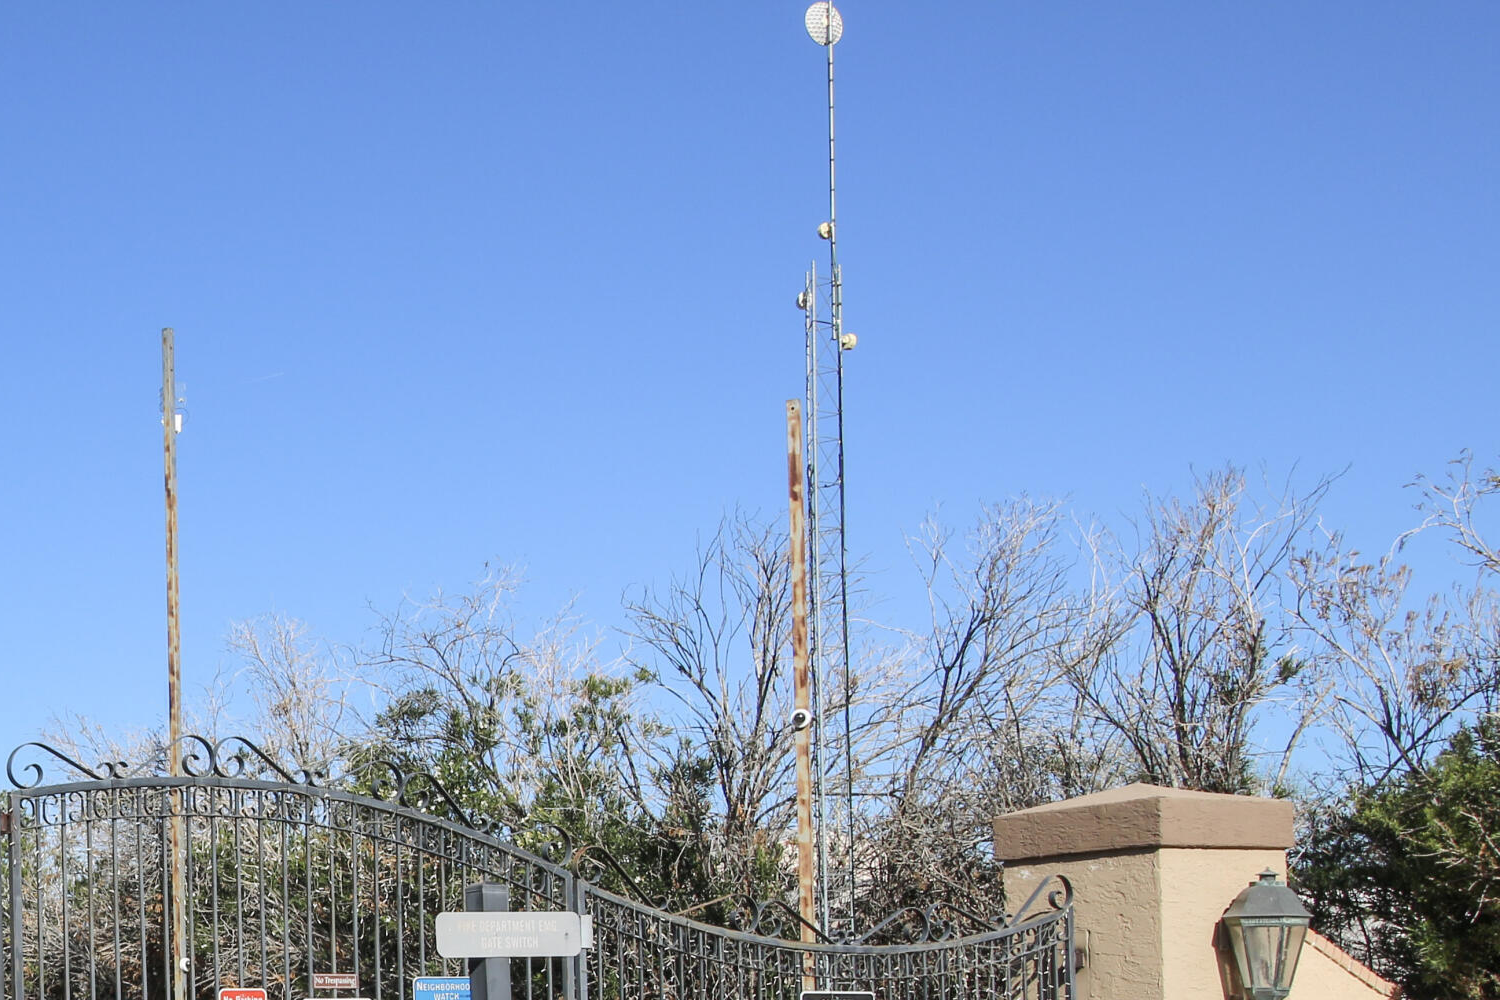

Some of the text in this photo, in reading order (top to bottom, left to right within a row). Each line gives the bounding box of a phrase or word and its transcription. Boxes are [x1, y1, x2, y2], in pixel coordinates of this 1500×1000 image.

[479, 920, 535, 932] DEPARTMENT
[481, 936, 539, 949] GATE SWITCH
[325, 976, 355, 987] Trespassing
[416, 982, 471, 991] NEIGHBORHOO
